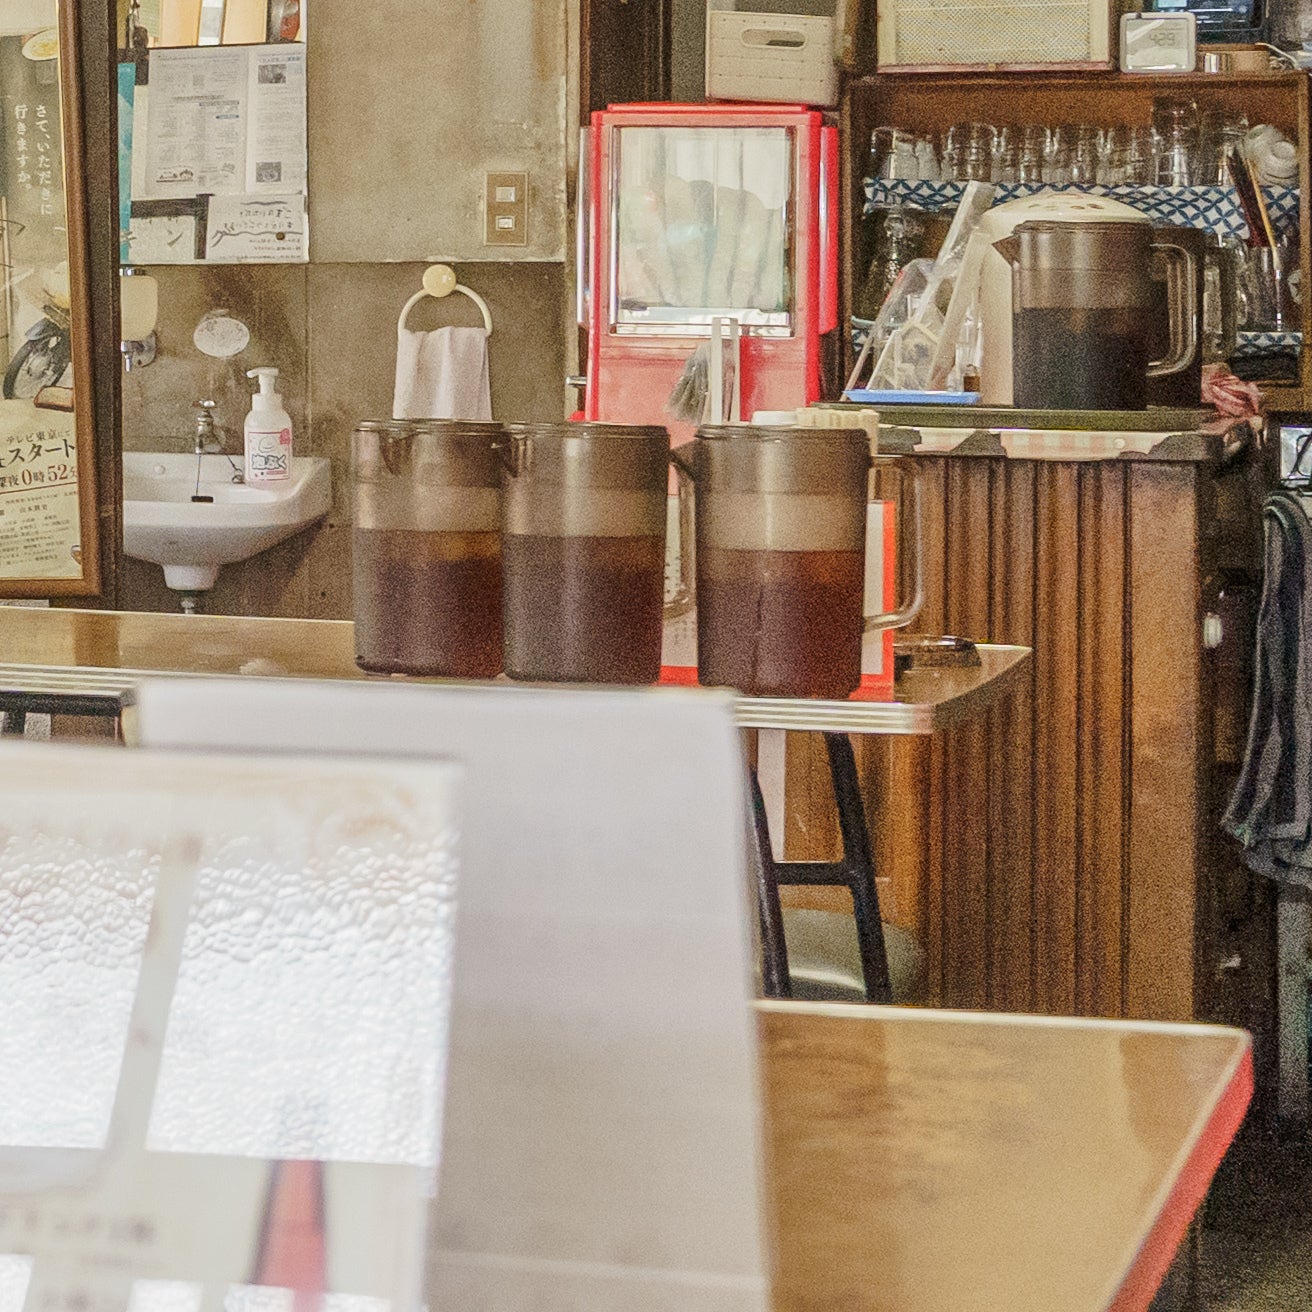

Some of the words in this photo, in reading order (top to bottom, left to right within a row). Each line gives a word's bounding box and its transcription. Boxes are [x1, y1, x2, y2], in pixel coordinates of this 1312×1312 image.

[15, 104, 32, 190] 行きますか。
[35, 104, 52, 215] さて、いただきに
